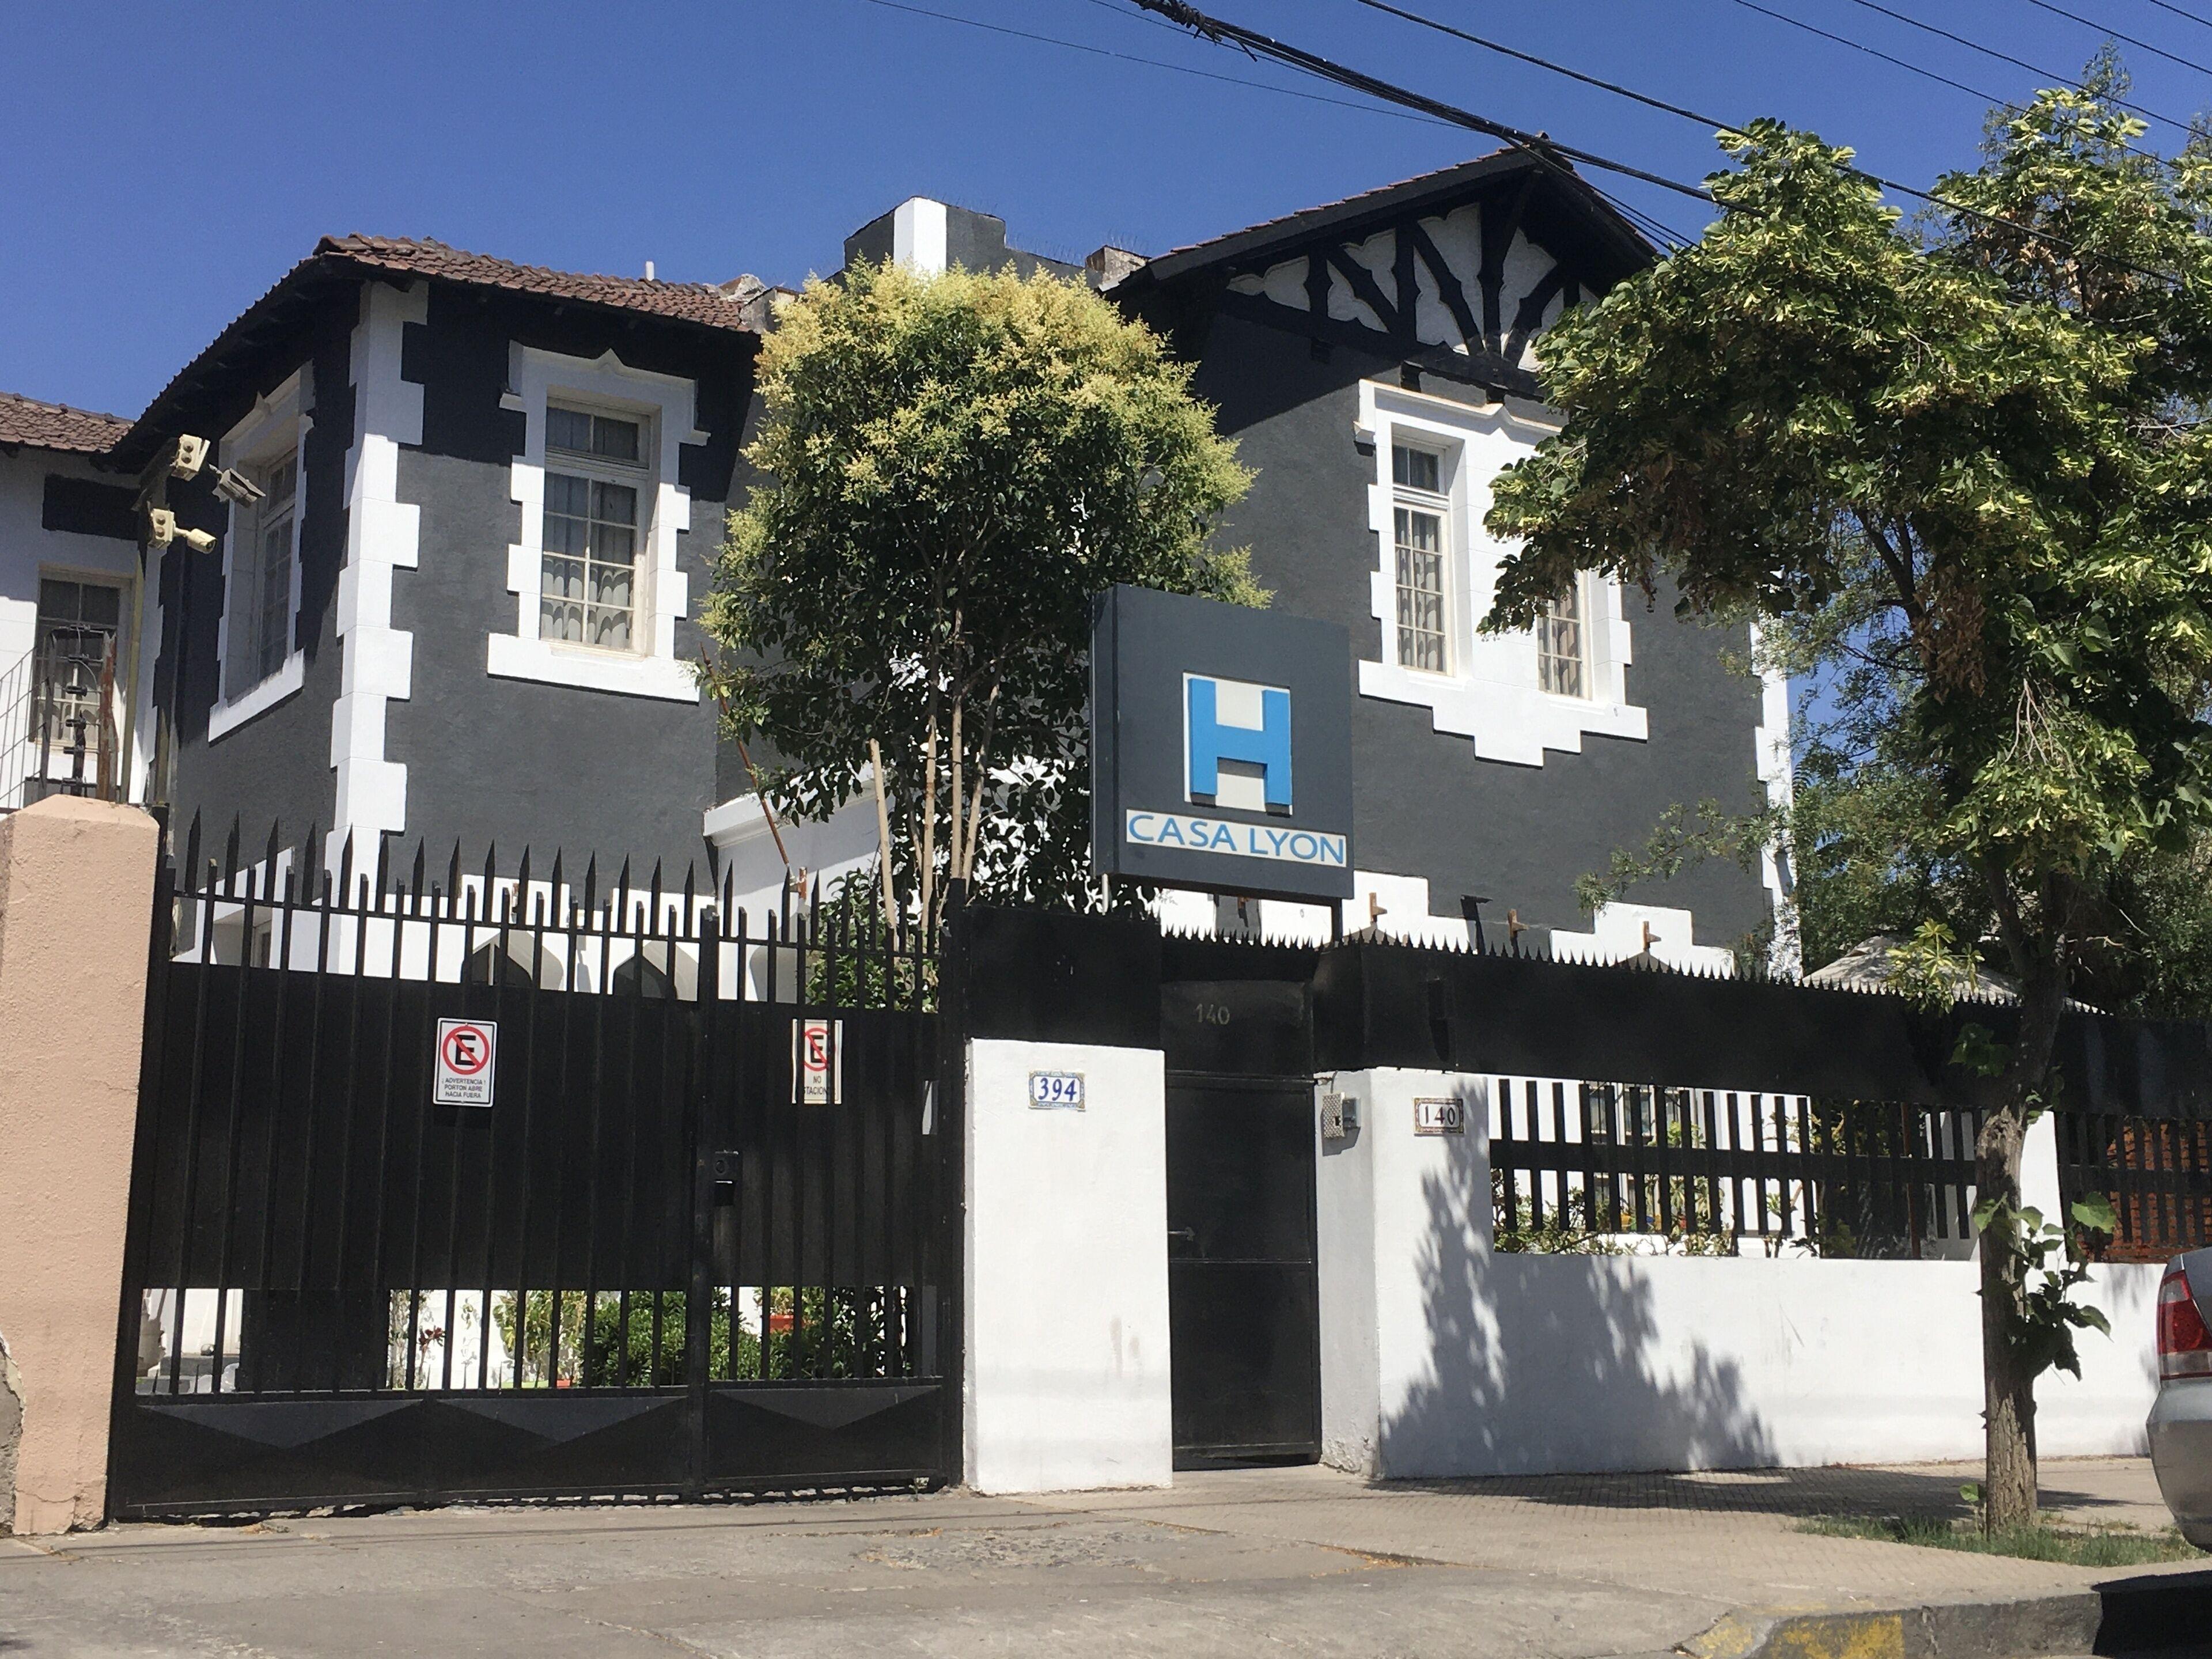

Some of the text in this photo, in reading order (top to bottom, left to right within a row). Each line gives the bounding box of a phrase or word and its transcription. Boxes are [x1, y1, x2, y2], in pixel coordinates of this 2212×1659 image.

[1188, 678, 1292, 806] H
[1128, 814, 1345, 865] CASA LYON
[1195, 1003, 1230, 1025] 140
[813, 1075, 822, 1084] NO
[1037, 1077, 1077, 1101] 394
[1423, 1106, 1456, 1125] 140
